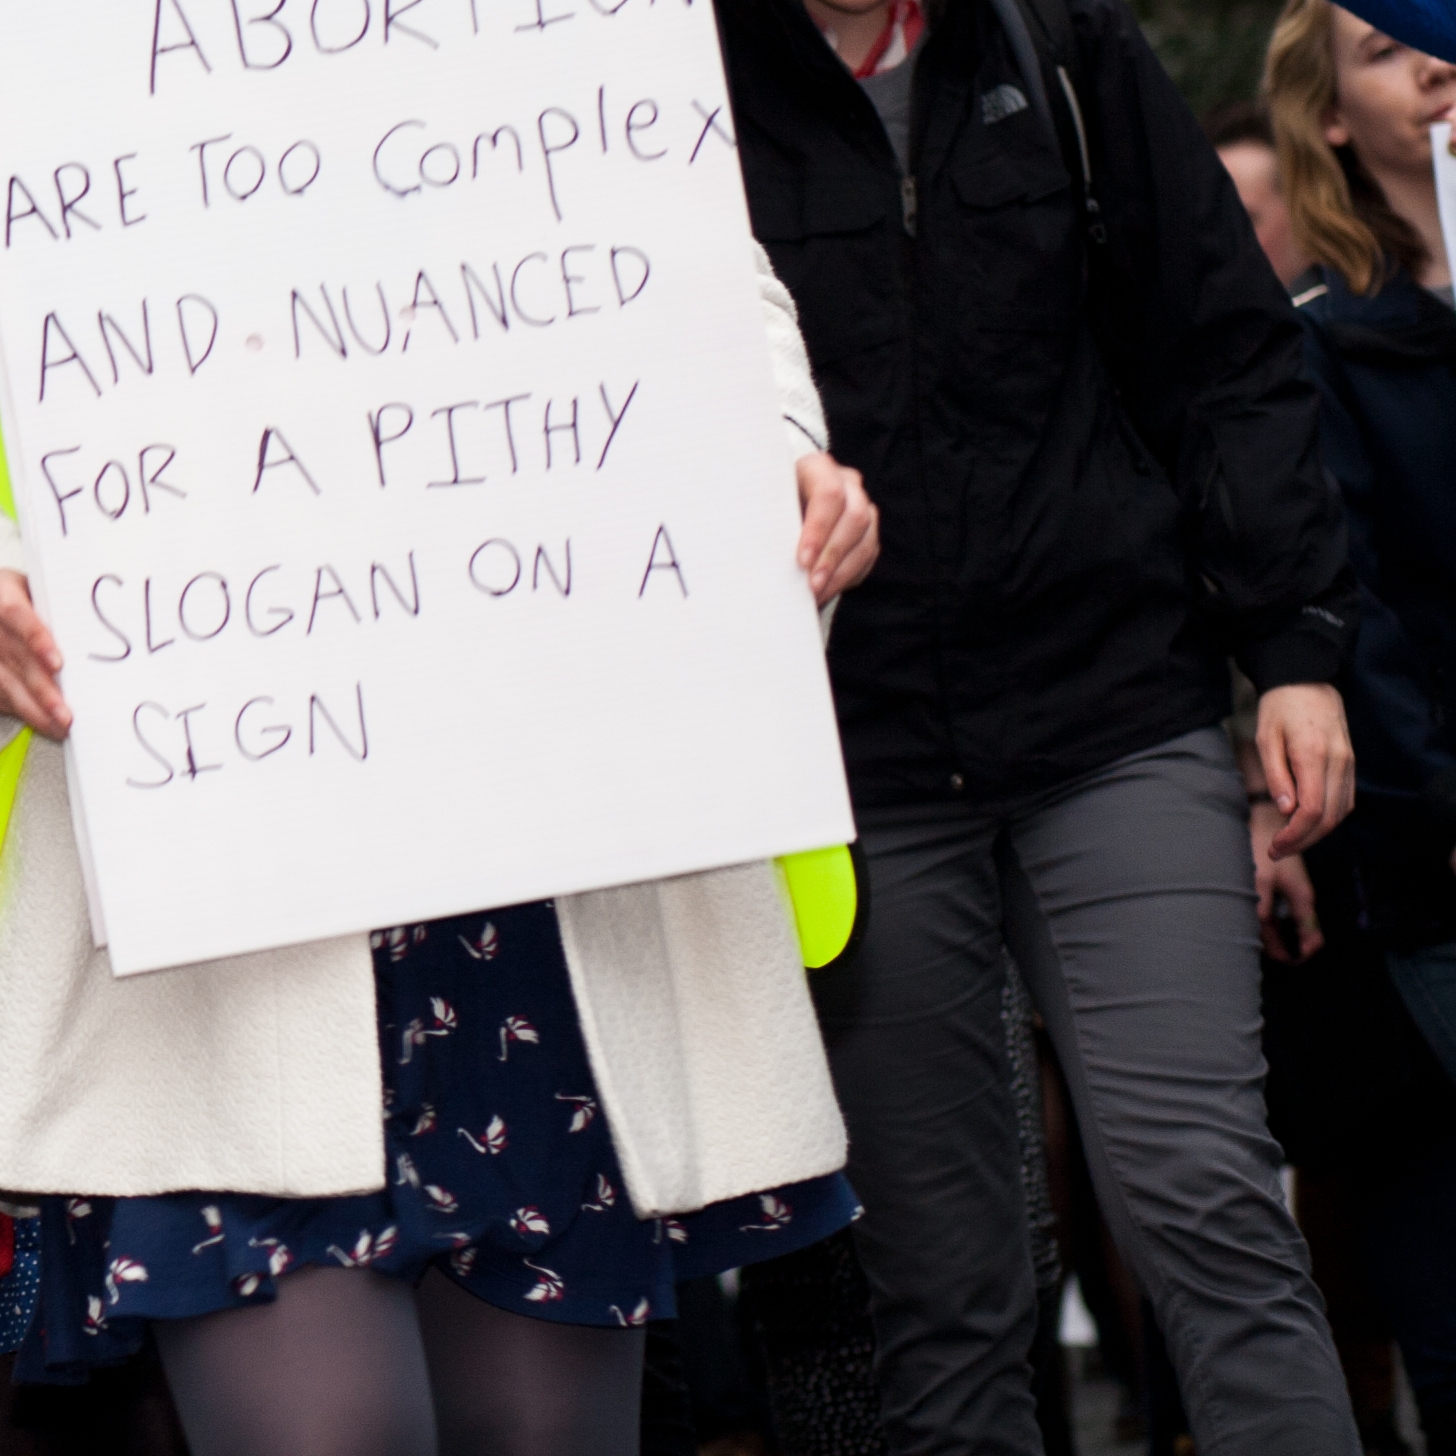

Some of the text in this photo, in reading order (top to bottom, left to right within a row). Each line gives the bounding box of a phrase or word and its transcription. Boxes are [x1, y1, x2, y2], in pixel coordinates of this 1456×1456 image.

[5, 153, 146, 248] ARE
[39, 245, 650, 402] AND NUANCED
[40, 381, 639, 536] FOR A PITHY
[90, 524, 688, 662] SLOGAN ON A
[127, 683, 368, 788] SIGN
